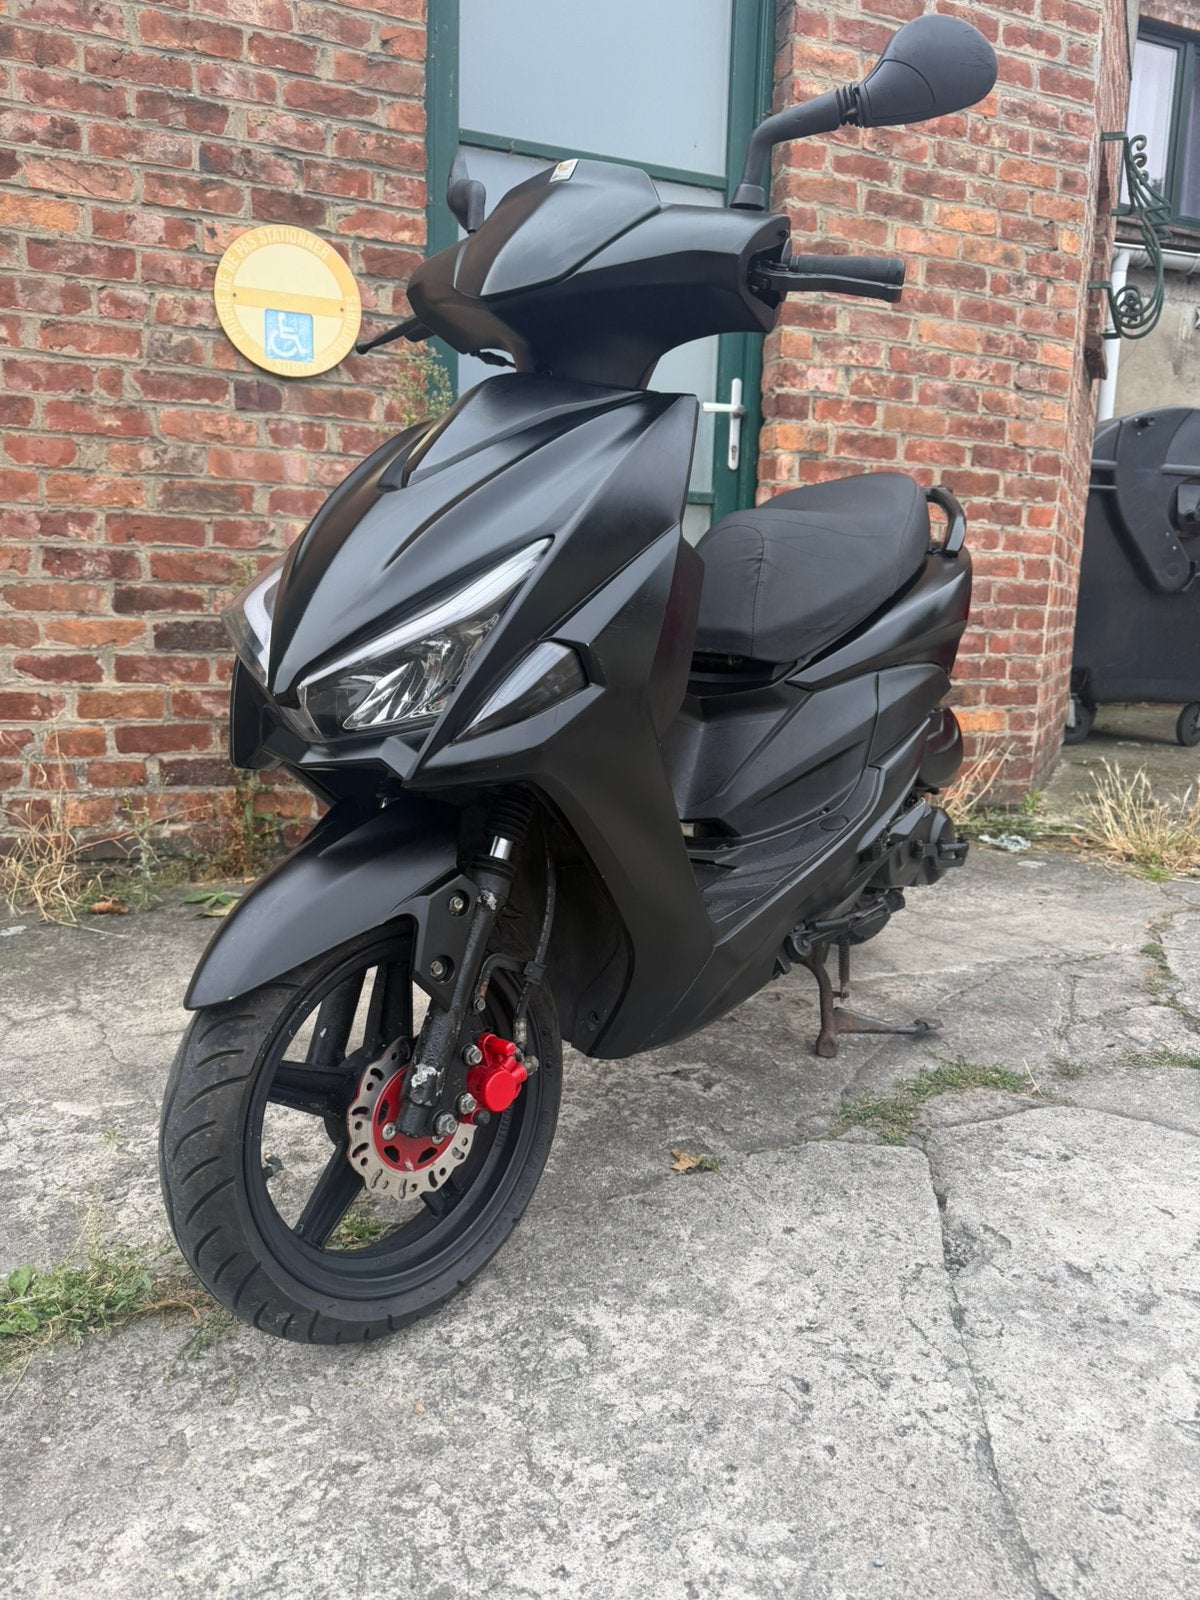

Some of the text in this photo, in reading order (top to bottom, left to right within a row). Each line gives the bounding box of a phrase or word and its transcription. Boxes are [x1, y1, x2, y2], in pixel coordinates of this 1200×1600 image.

[234, 234, 258, 257] PAS
[257, 227, 331, 261] STATIONNER
[221, 253, 240, 273] NE
[217, 273, 231, 291] DE
